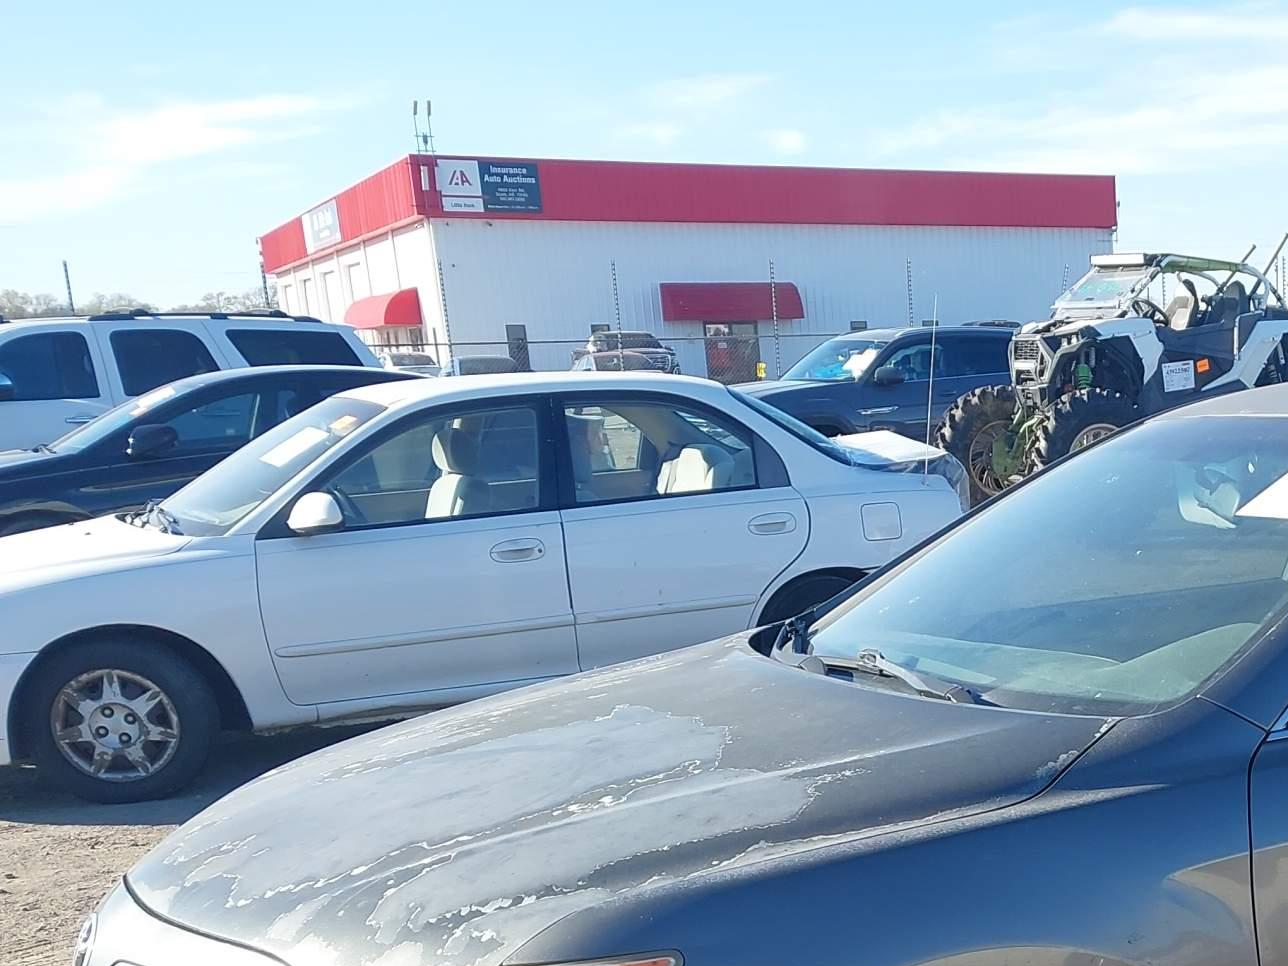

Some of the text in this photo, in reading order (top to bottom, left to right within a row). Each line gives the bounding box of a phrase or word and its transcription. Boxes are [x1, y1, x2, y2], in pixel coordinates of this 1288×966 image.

[490, 165, 527, 174] Insurance
[484, 174, 536, 184] Auto Auctions
